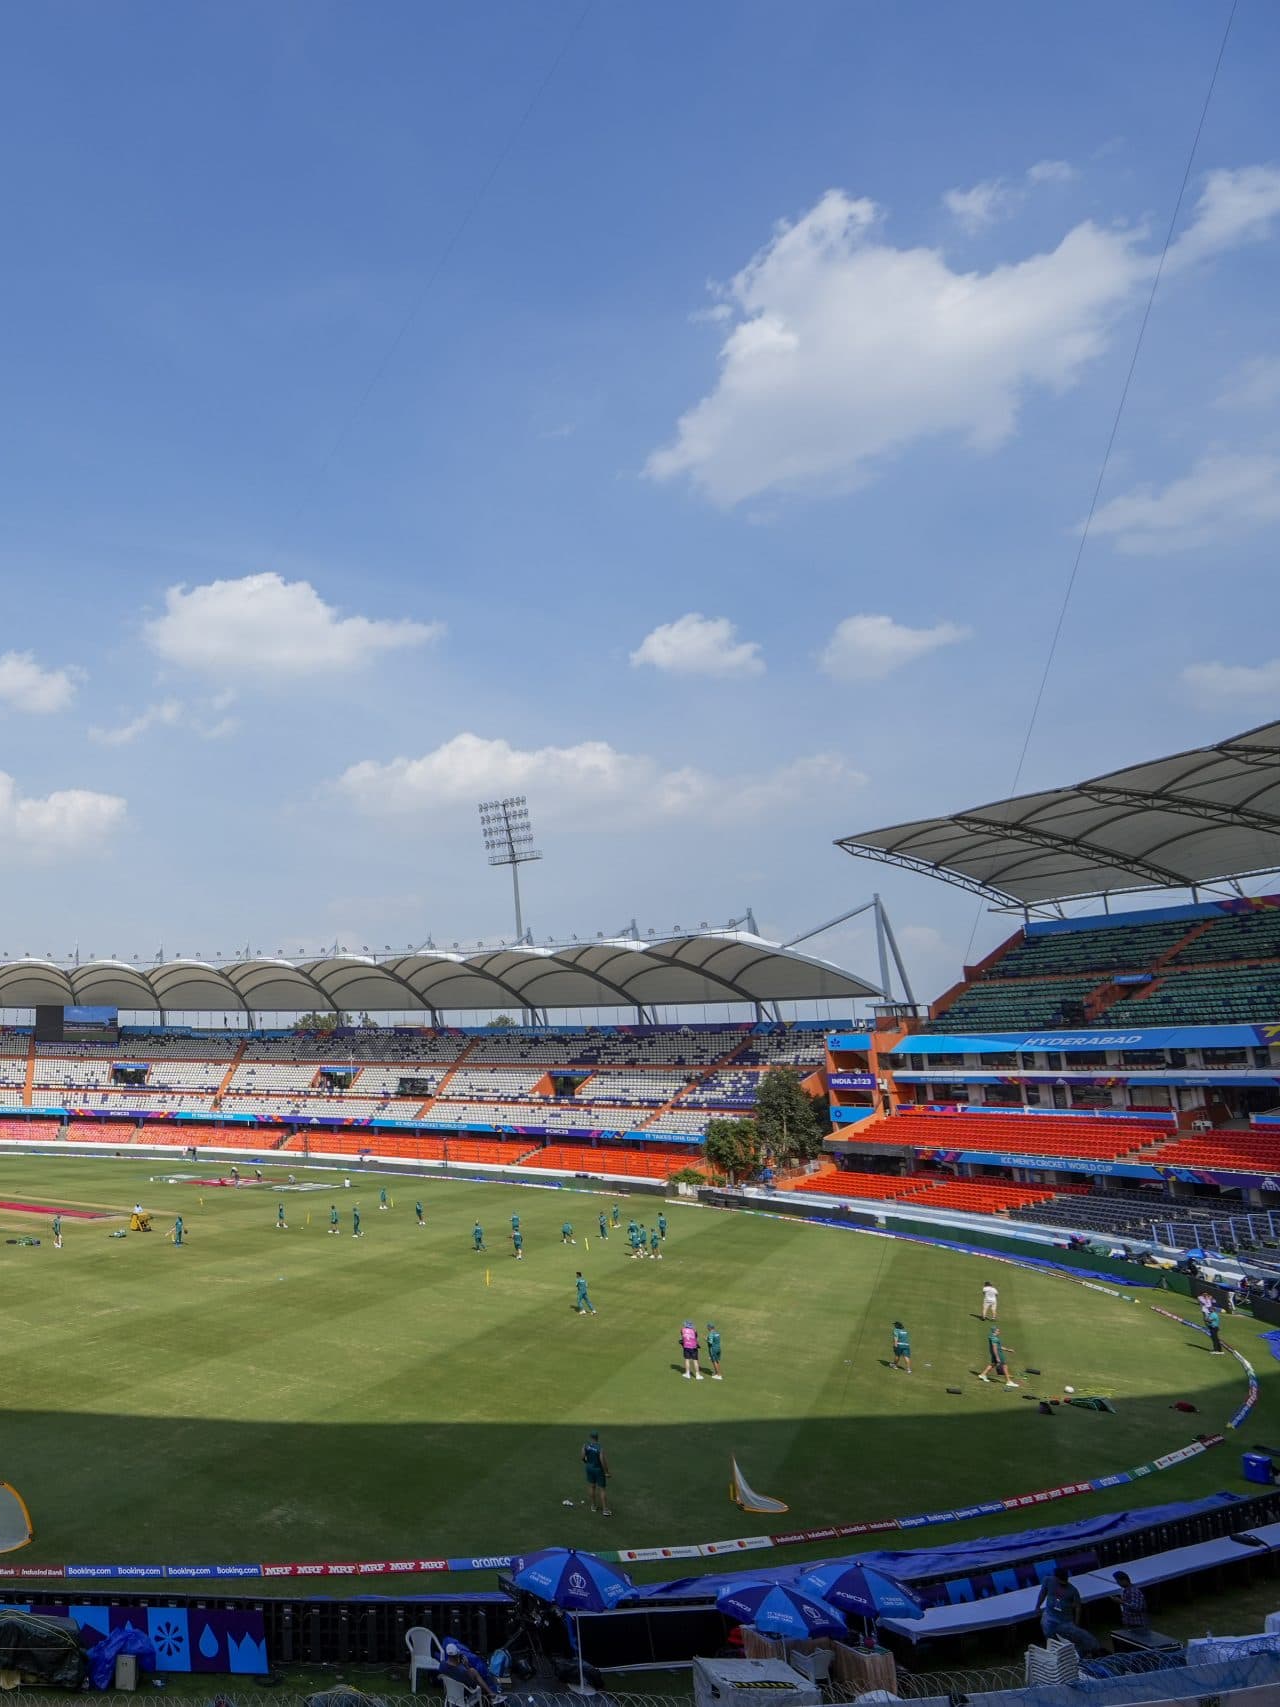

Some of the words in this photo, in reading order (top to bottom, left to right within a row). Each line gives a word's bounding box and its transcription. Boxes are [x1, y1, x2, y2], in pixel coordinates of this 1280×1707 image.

[507, 1027, 559, 1035] HYDERABAD
[1023, 1035, 1143, 1047] HYDERABAD
[1034, 1159, 1066, 1169] CRICKET
[1068, 1161, 1095, 1172] WORLD
[1096, 1163, 1113, 1173] CUP
[359, 1563, 385, 1572] MRF
[389, 1562, 416, 1571] MRF
[419, 1561, 446, 1570] MRF
[471, 1556, 511, 1569] aramco
[0, 1568, 15, 1576] Bank
[47, 1569, 63, 1577] Bank
[68, 1567, 112, 1575] Booking.com
[118, 1567, 161, 1576] Booking.com
[168, 1567, 211, 1576] Booking.com
[216, 1566, 259, 1576] Booking.com
[265, 1566, 292, 1576] MRF
[297, 1565, 324, 1574] MRF
[328, 1565, 355, 1574] MRF
[836, 1591, 867, 1604] #CWC23
